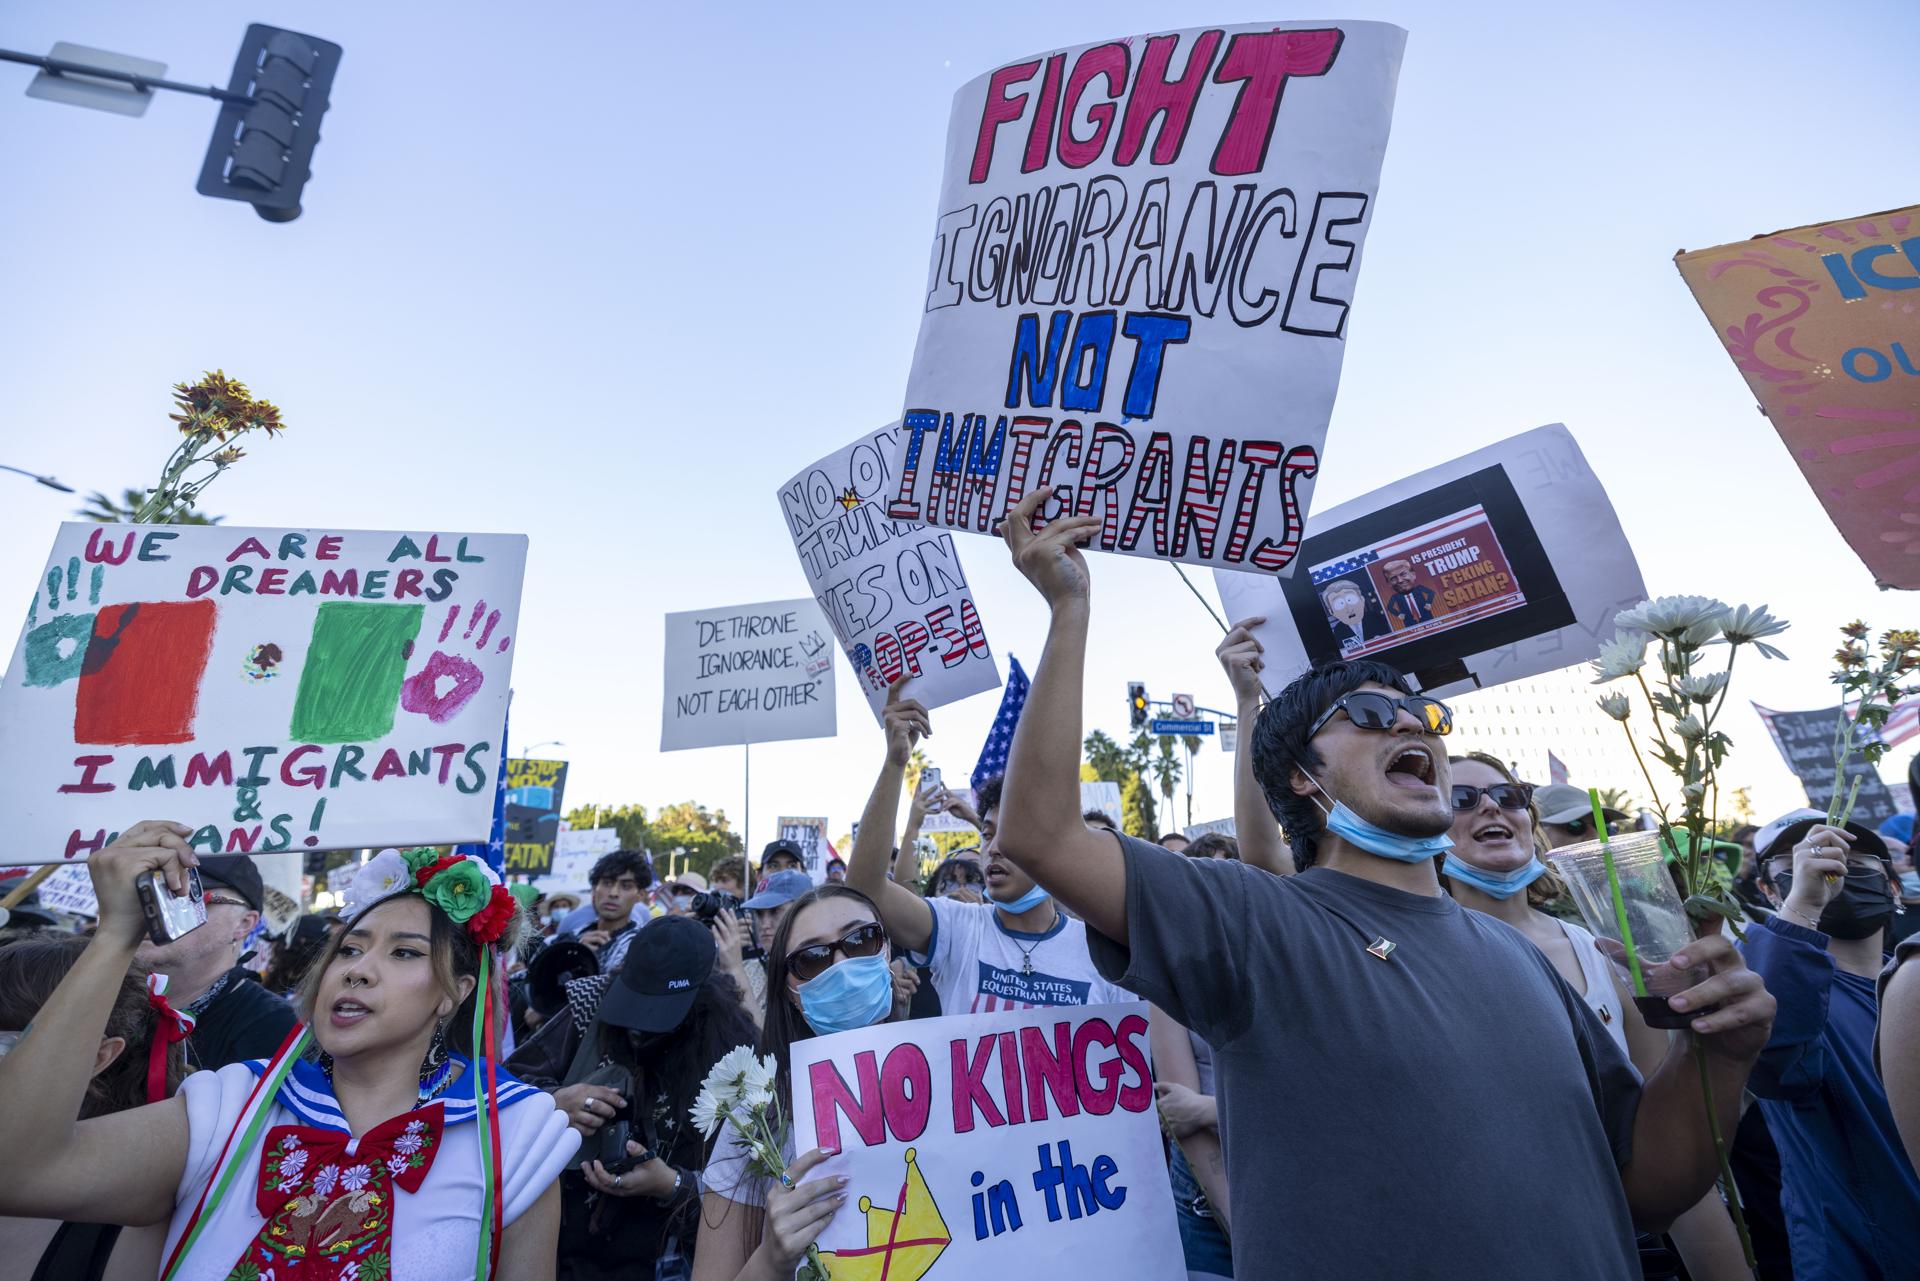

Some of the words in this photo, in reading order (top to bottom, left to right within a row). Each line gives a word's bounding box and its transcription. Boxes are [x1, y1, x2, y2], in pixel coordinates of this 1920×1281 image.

[969, 28, 1344, 184] FIGHT
[926, 174, 1369, 340] IGNORANCE
[1004, 309, 1191, 420] NOT
[783, 470, 836, 536] NO
[888, 409, 1318, 571] IMMIGRANTS
[84, 528, 179, 566] WE
[226, 534, 345, 563] ARE
[387, 535, 485, 564] ALL
[798, 495, 926, 579] TRUM
[1410, 554, 1421, 564] IS
[1421, 537, 1467, 559] PRESIDENT
[1424, 545, 1480, 577] TRUMP
[185, 565, 459, 602] DREAMERS
[818, 564, 893, 642] YES
[897, 533, 967, 605] ON
[1443, 572, 1510, 608] SATAN?
[696, 647, 799, 679] IGNORANCE,
[677, 691, 713, 718] NOT
[718, 688, 758, 713] EACH
[1155, 722, 1201, 732] Commercial
[57, 741, 490, 795] IMMIGRANTS
[526, 760, 563, 775] STOP
[233, 786, 263, 823] &
[64, 797, 328, 859] HANS!
[668, 979, 690, 989] PUMA
[982, 980, 1046, 1001] EQUESTRIAN
[1052, 992, 1082, 1005] TEAM
[992, 970, 1028, 989] UNITED
[1034, 982, 1072, 993] STATES
[809, 1043, 932, 1155] NO
[951, 1014, 1154, 1135] KINGS
[970, 1171, 1023, 1241] in
[1033, 1140, 1128, 1222] the
